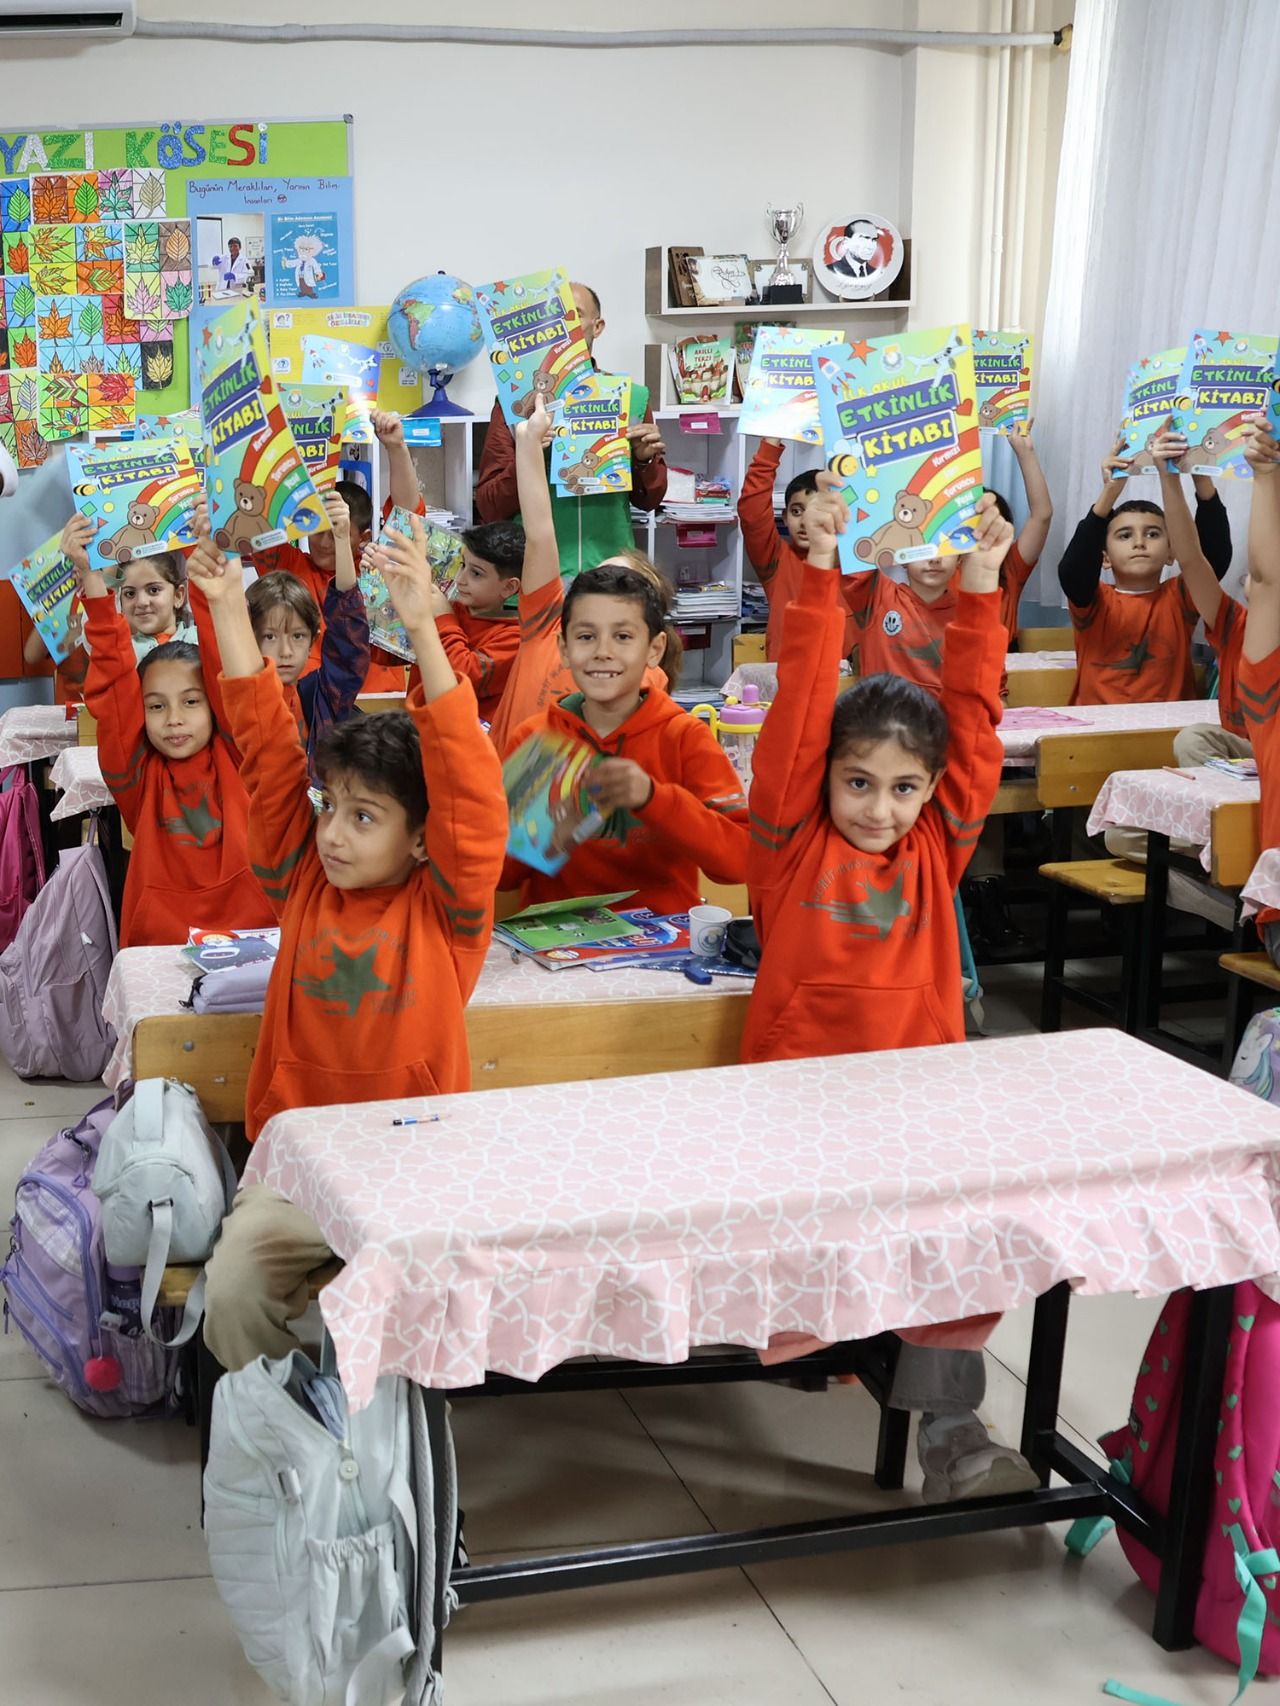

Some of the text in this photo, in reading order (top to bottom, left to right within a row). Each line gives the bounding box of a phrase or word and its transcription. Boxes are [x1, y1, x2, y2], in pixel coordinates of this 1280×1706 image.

[318, 178, 338, 190] Bilim
[492, 302, 562, 335] ETKİNLİK
[509, 323, 565, 352] KİTABI
[762, 357, 813, 368] ETKİNL
[769, 371, 815, 386] KİTAB
[1193, 368, 1274, 383] ETKİNLİK
[203, 360, 258, 416] ETKİNLİK
[1199, 390, 1264, 405] KİTABI
[564, 404, 619, 414] ETKİNLİK
[839, 383, 955, 428] ETKİNLİK
[212, 400, 263, 447] KİTABI
[572, 419, 617, 432] KİTABI
[864, 419, 953, 458] KİTABI
[297, 444, 325, 458] ABI
[83, 452, 175, 475] ETKİNLİK
[100, 466, 175, 486] KİTABI
[43, 577, 76, 608] KİTAB
